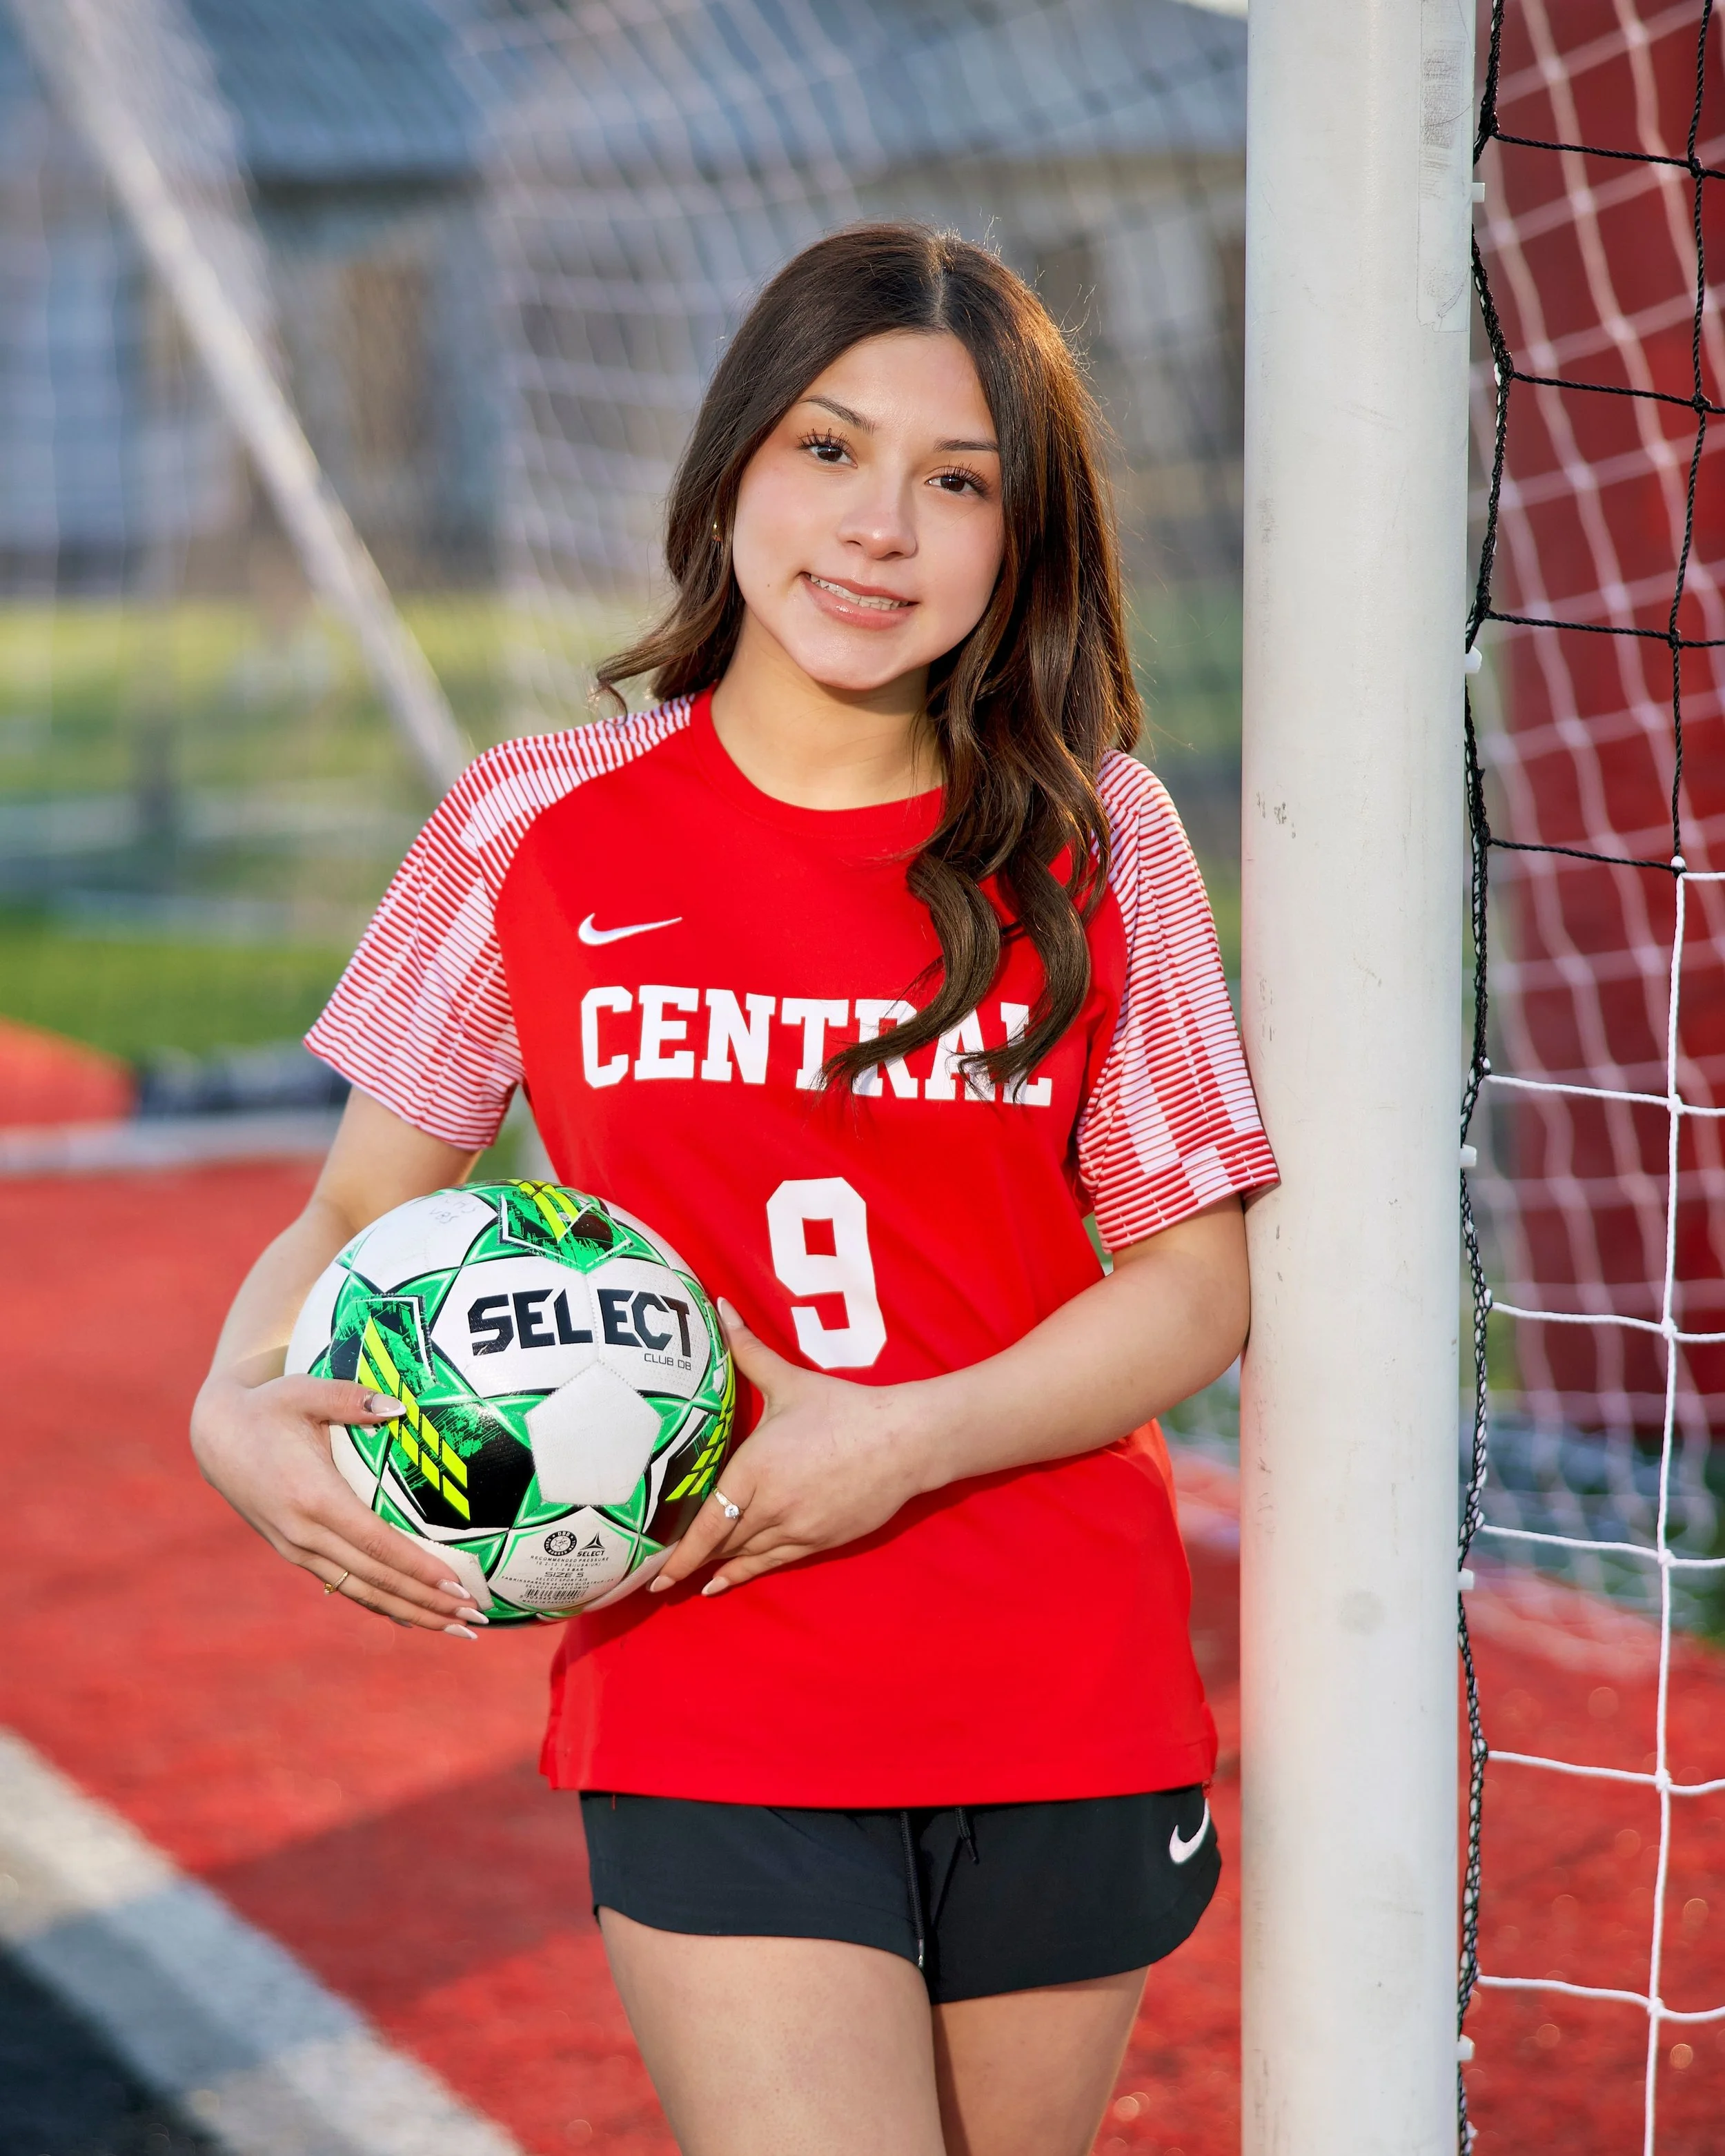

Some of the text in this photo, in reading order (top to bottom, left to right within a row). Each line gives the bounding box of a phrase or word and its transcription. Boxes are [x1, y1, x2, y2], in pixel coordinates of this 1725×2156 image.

[580, 985, 1053, 1107] CENTRAL
[766, 1177, 887, 1369] 9
[467, 1288, 691, 1358] SELECT
[644, 1353, 692, 1371] CLUB DB
